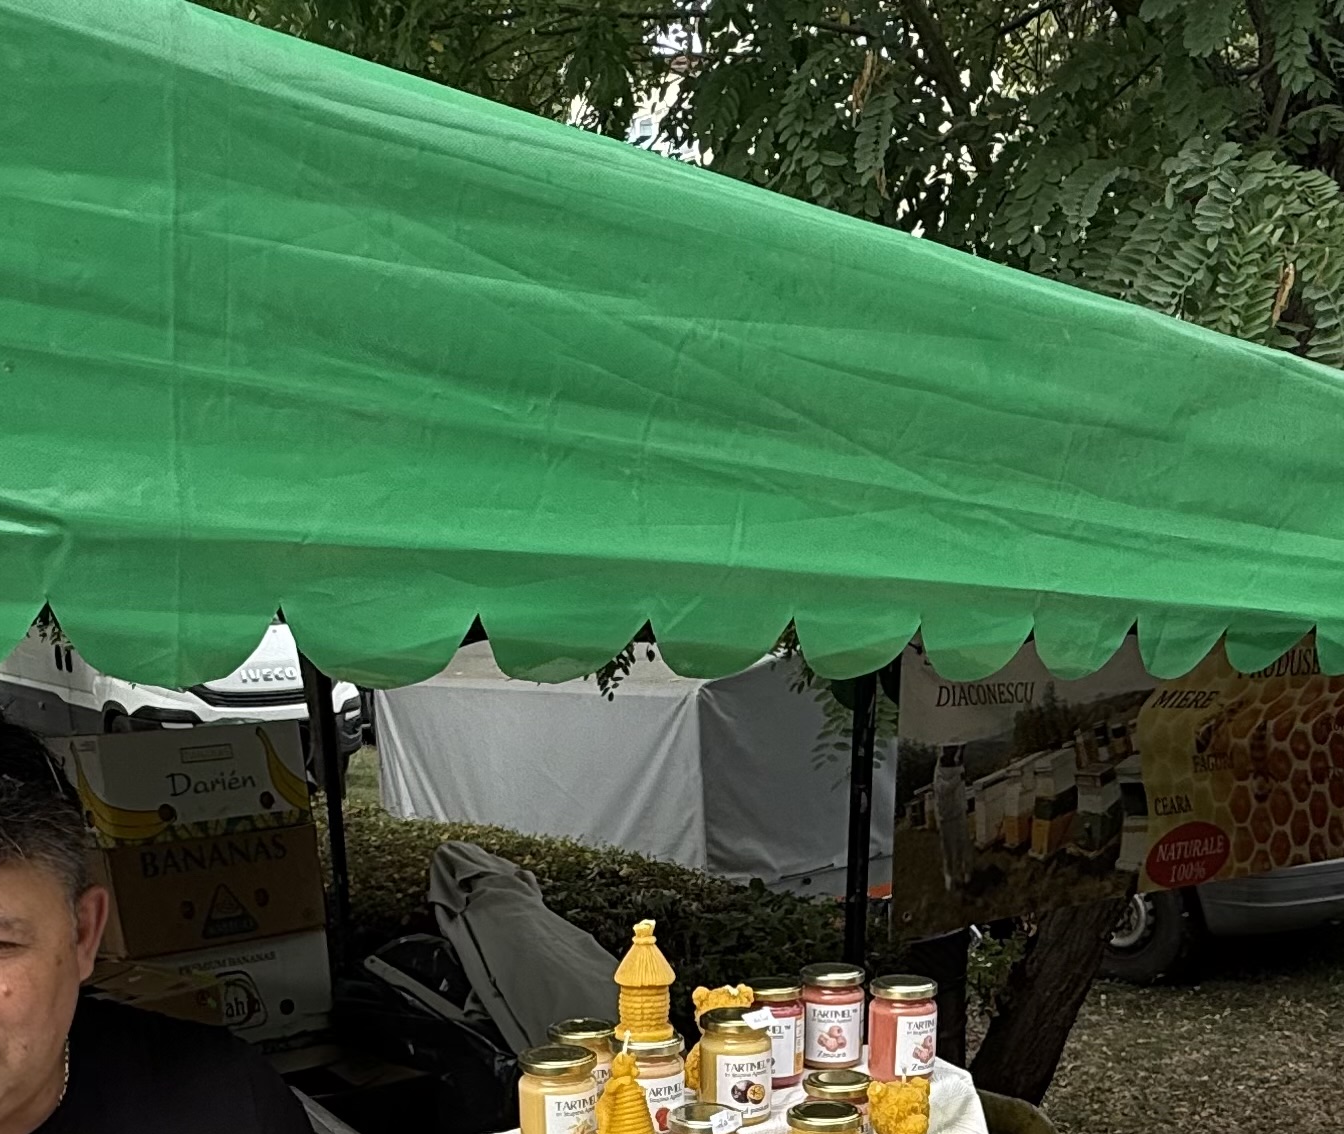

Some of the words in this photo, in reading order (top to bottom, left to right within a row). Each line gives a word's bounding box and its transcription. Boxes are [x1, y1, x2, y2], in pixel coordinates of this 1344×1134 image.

[240, 666, 297, 683] IVECO
[936, 682, 1034, 707] DIACONESCU
[1152, 689, 1219, 709] MIERE
[166, 769, 256, 797] Darién
[1154, 794, 1192, 817] CEARA
[141, 833, 288, 878] BANANAS
[1156, 834, 1225, 864] NATURALE
[1170, 863, 1207, 884] 100%
